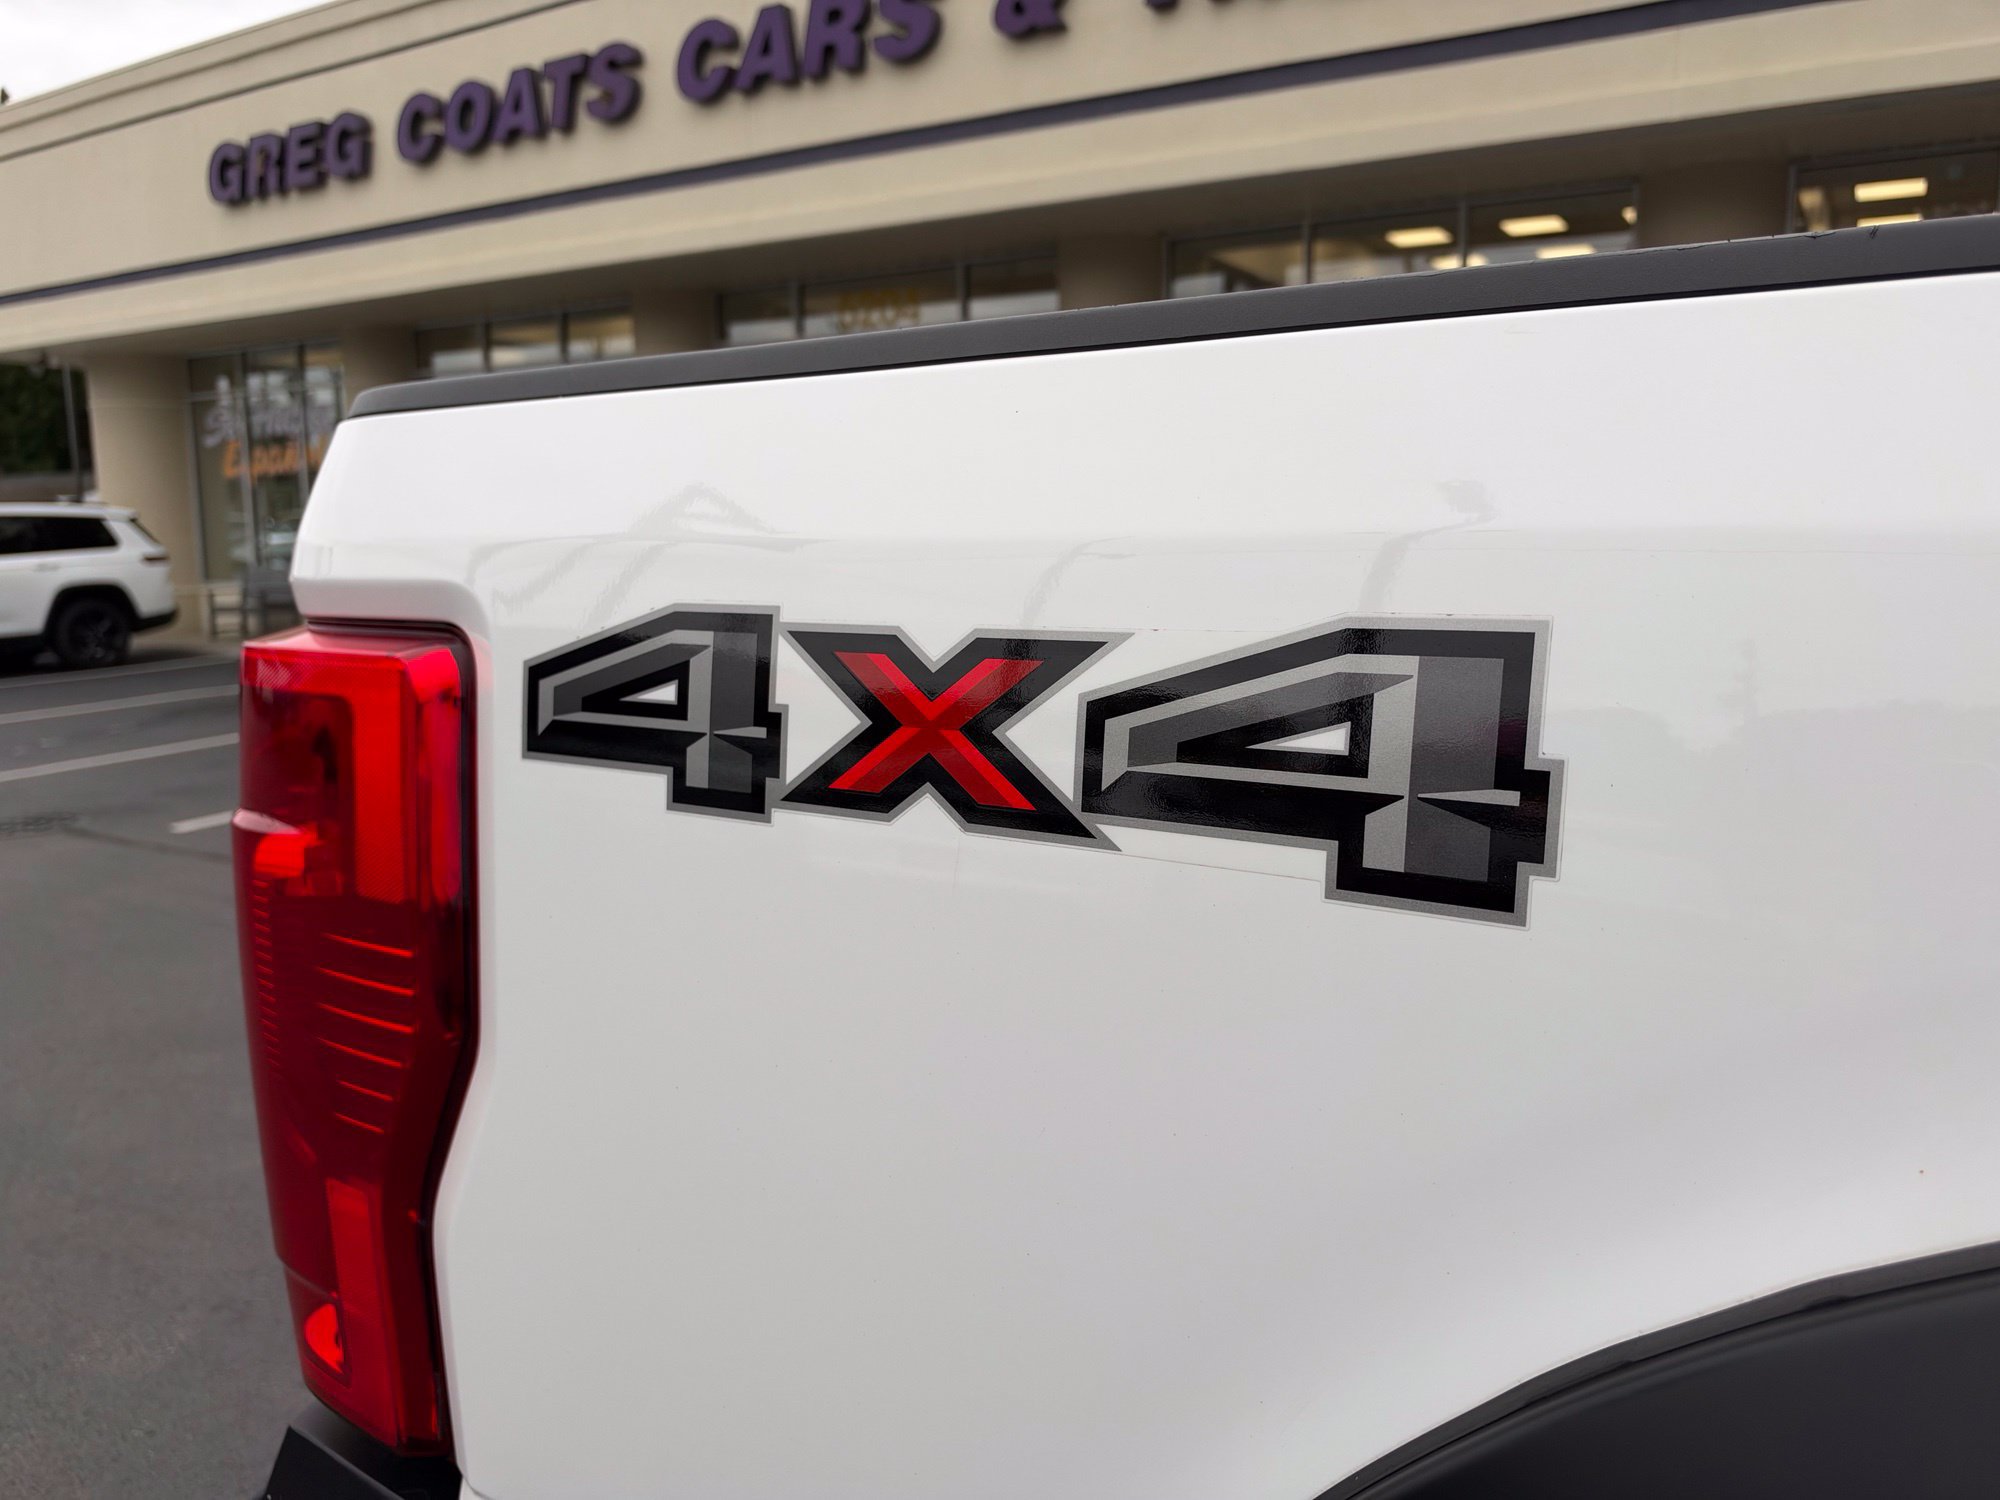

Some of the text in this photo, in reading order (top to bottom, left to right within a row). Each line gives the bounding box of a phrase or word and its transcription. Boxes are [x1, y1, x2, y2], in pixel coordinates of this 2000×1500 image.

[209, 0, 941, 206] GREG COATS CARS
